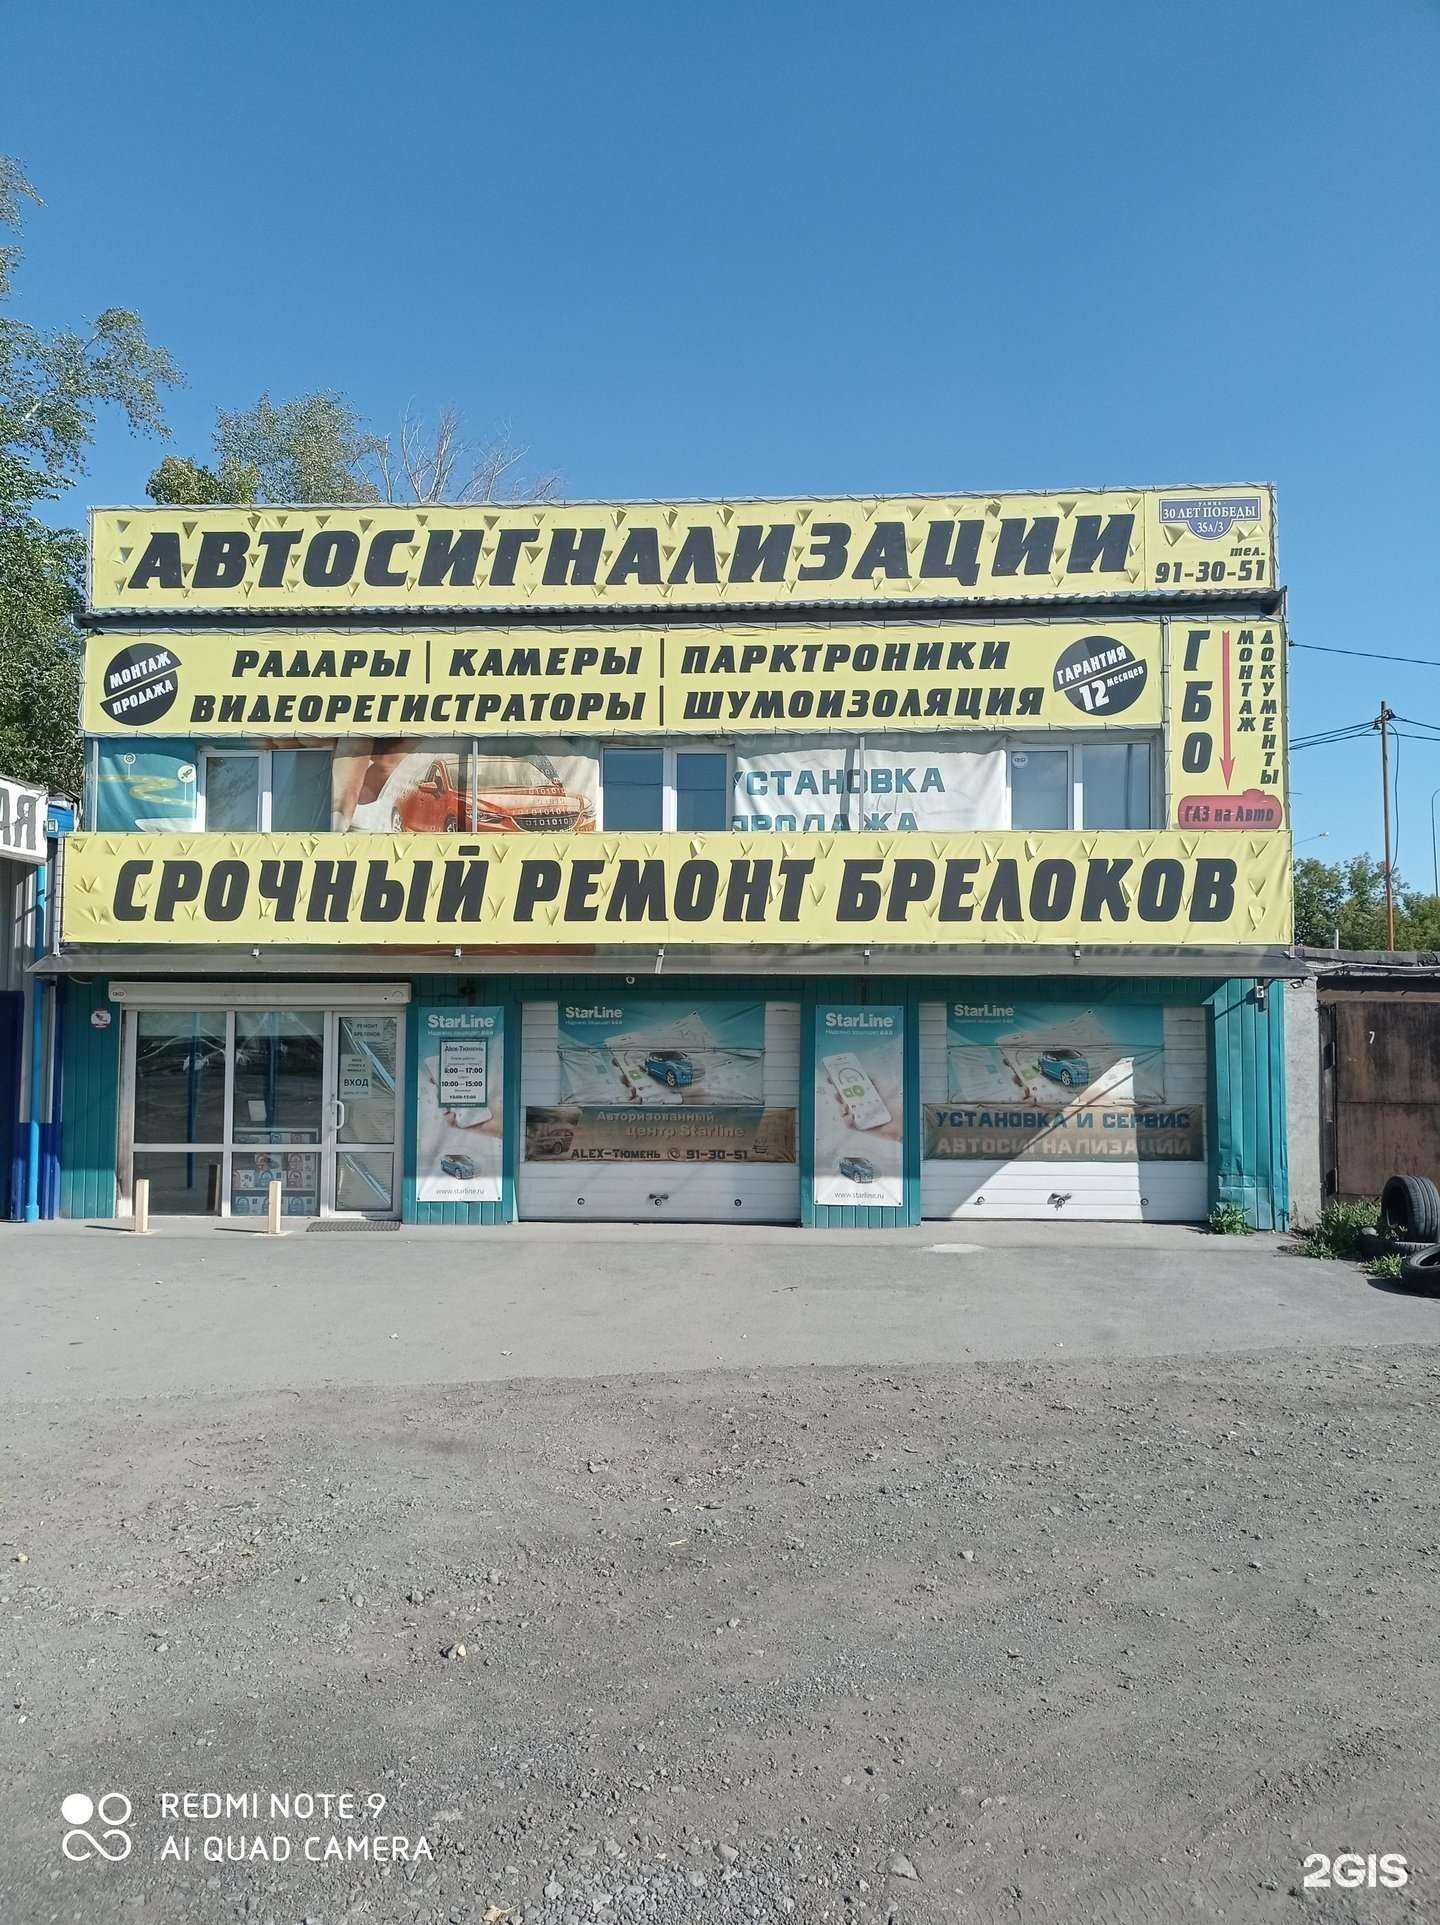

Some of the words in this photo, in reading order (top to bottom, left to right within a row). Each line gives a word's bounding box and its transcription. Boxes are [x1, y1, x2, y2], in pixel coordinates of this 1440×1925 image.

[1163, 509, 1176, 519] 30
[1178, 508, 1201, 518] ЛЕТ
[1202, 506, 1256, 519] ПОБЕДЫ
[126, 513, 1136, 590] АВТОСИГНАЛИЗАЦИИ
[1154, 559, 1266, 583] 91-30-51
[109, 651, 172, 689] МОНТАЖ
[231, 649, 411, 678] РАДАРЫ
[449, 646, 643, 677] КАМЕРЫ
[680, 641, 1011, 674] ПАРКТРОНИКИ
[1056, 645, 1127, 685] ГАРАНТИЯ
[112, 679, 174, 715] ПРОДАЖА
[1079, 680, 1110, 711] 12
[1106, 665, 1144, 688] месяцев
[1236, 630, 1256, 732] МОНТАЖ
[189, 692, 646, 723] ВИДЕОРЕГИСТРАТОРЫ
[682, 686, 1045, 720] ШУМОИЗОЛЯЦИЯ
[1181, 630, 1213, 774] ГБО
[1260, 629, 1280, 785] ДОКУМЕНТЫ
[1184, 805, 1210, 822] ГАЗ
[1214, 807, 1231, 821] на
[1235, 804, 1275, 822] Авто
[112, 845, 490, 922] СРОЧНЫЙ
[513, 857, 817, 922] РЕМОНТ
[836, 857, 1237, 922] БРЕЛОКОВ
[427, 1013, 495, 1029] StarLine
[565, 1006, 623, 1019] StarLine
[825, 1012, 894, 1028] StarLine
[954, 1004, 1015, 1017] StarLine
[343, 1078, 369, 1087] ВХОД
[936, 1111, 1068, 1128] УСТАНОВКА
[1076, 1112, 1093, 1128] И
[1102, 1112, 1191, 1129] СЕРВИС
[686, 1149, 748, 1160] 91-30-51
